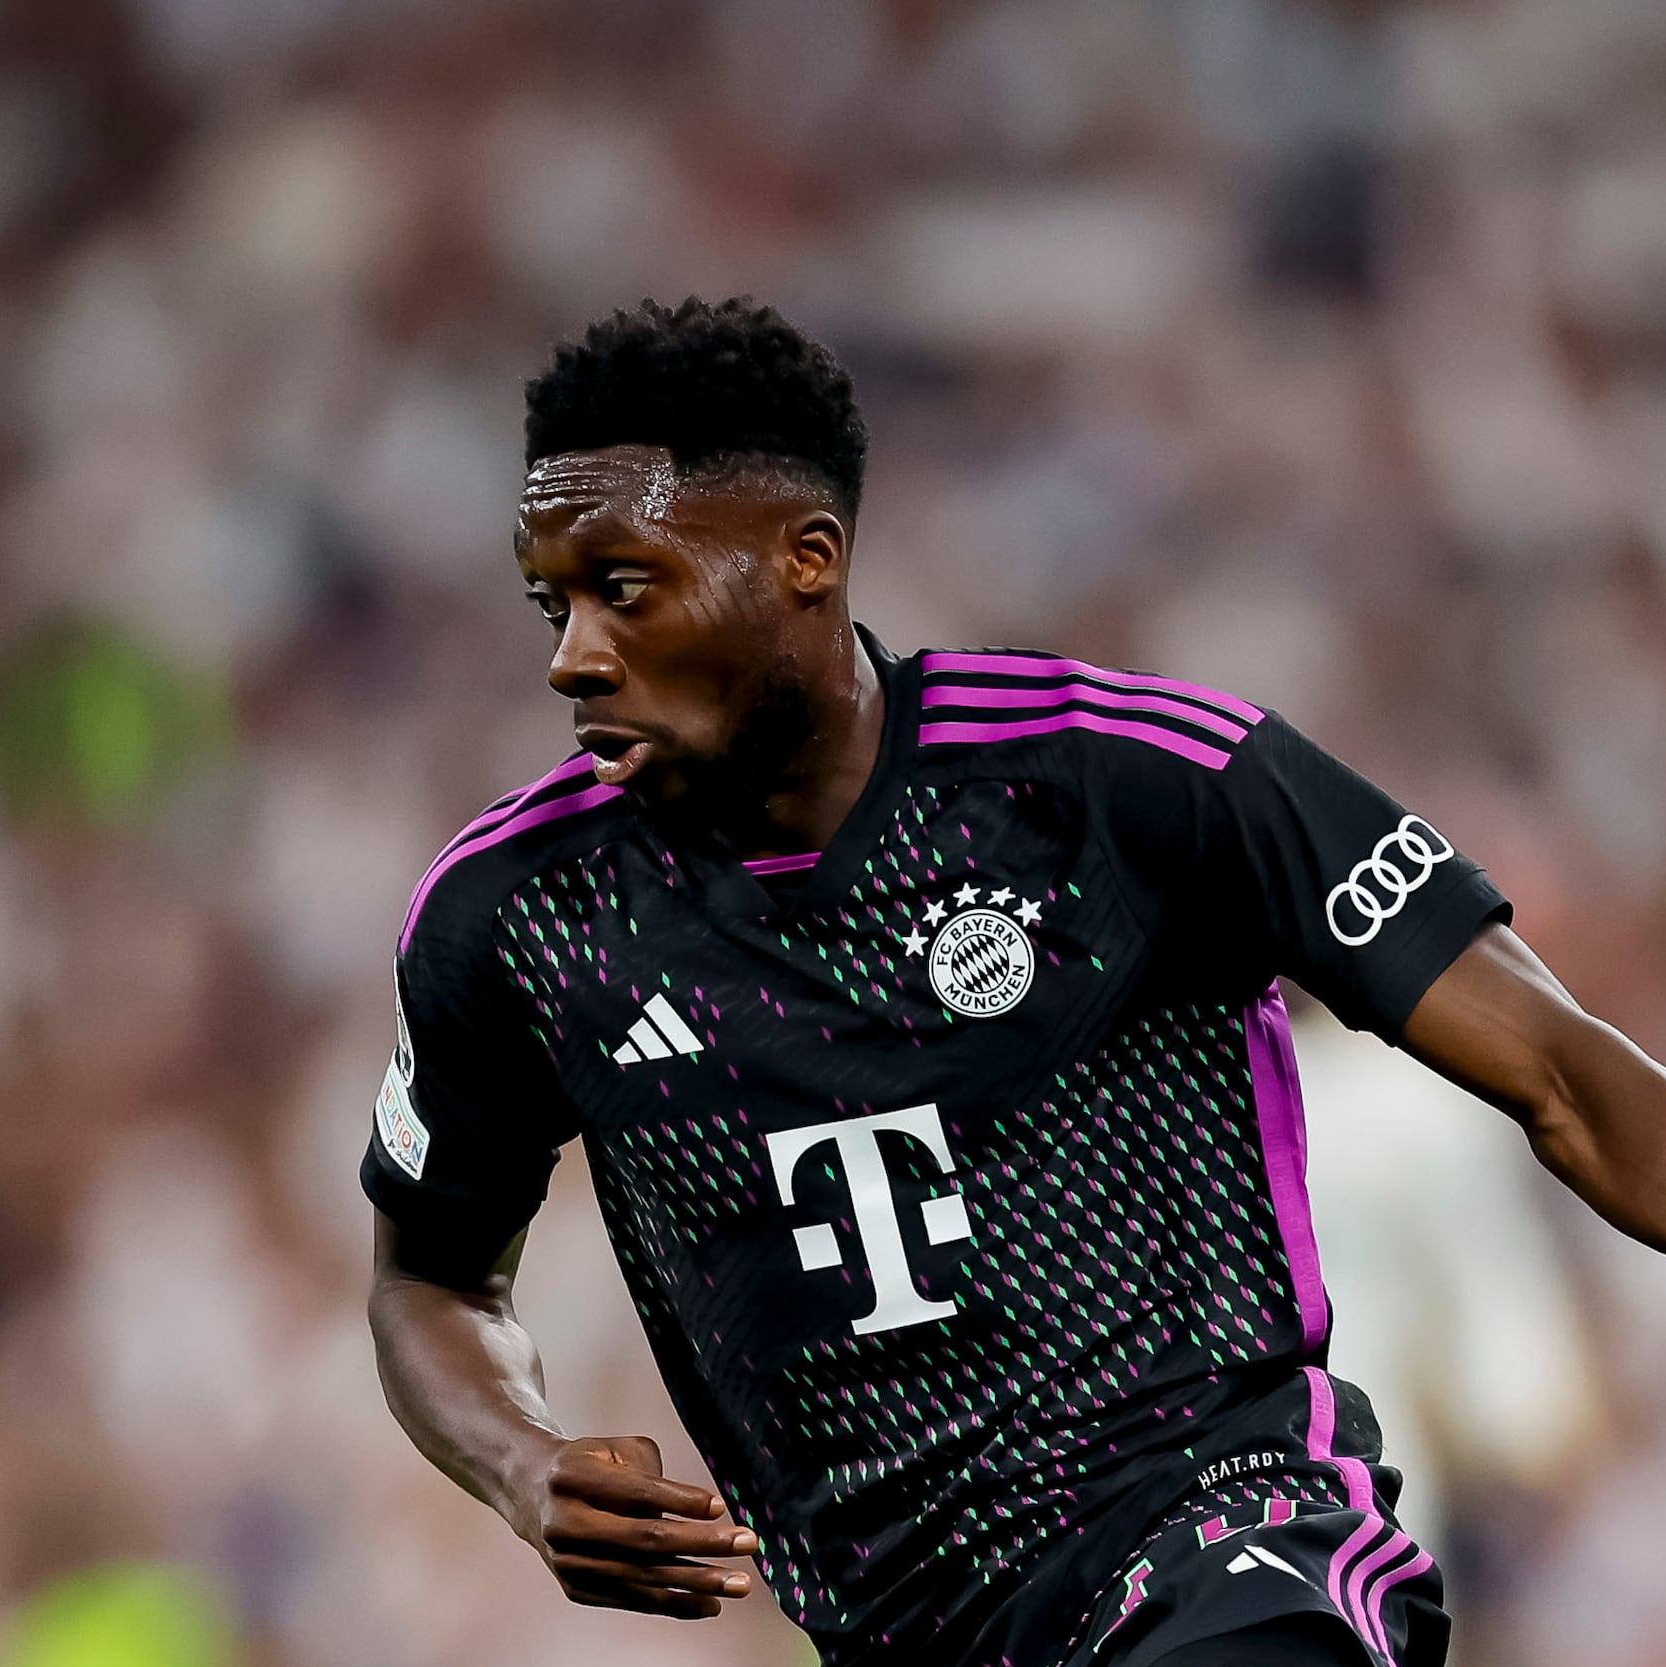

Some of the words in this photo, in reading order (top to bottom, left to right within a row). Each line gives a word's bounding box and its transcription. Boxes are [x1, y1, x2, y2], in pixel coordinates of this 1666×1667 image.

[936, 942, 952, 966] FC
[950, 918, 1018, 948] BAYERN
[944, 964, 1026, 1010] MÜNCHEN
[765, 1103, 958, 1336] T
[1197, 1451, 1286, 1490] HEAT.RDY
